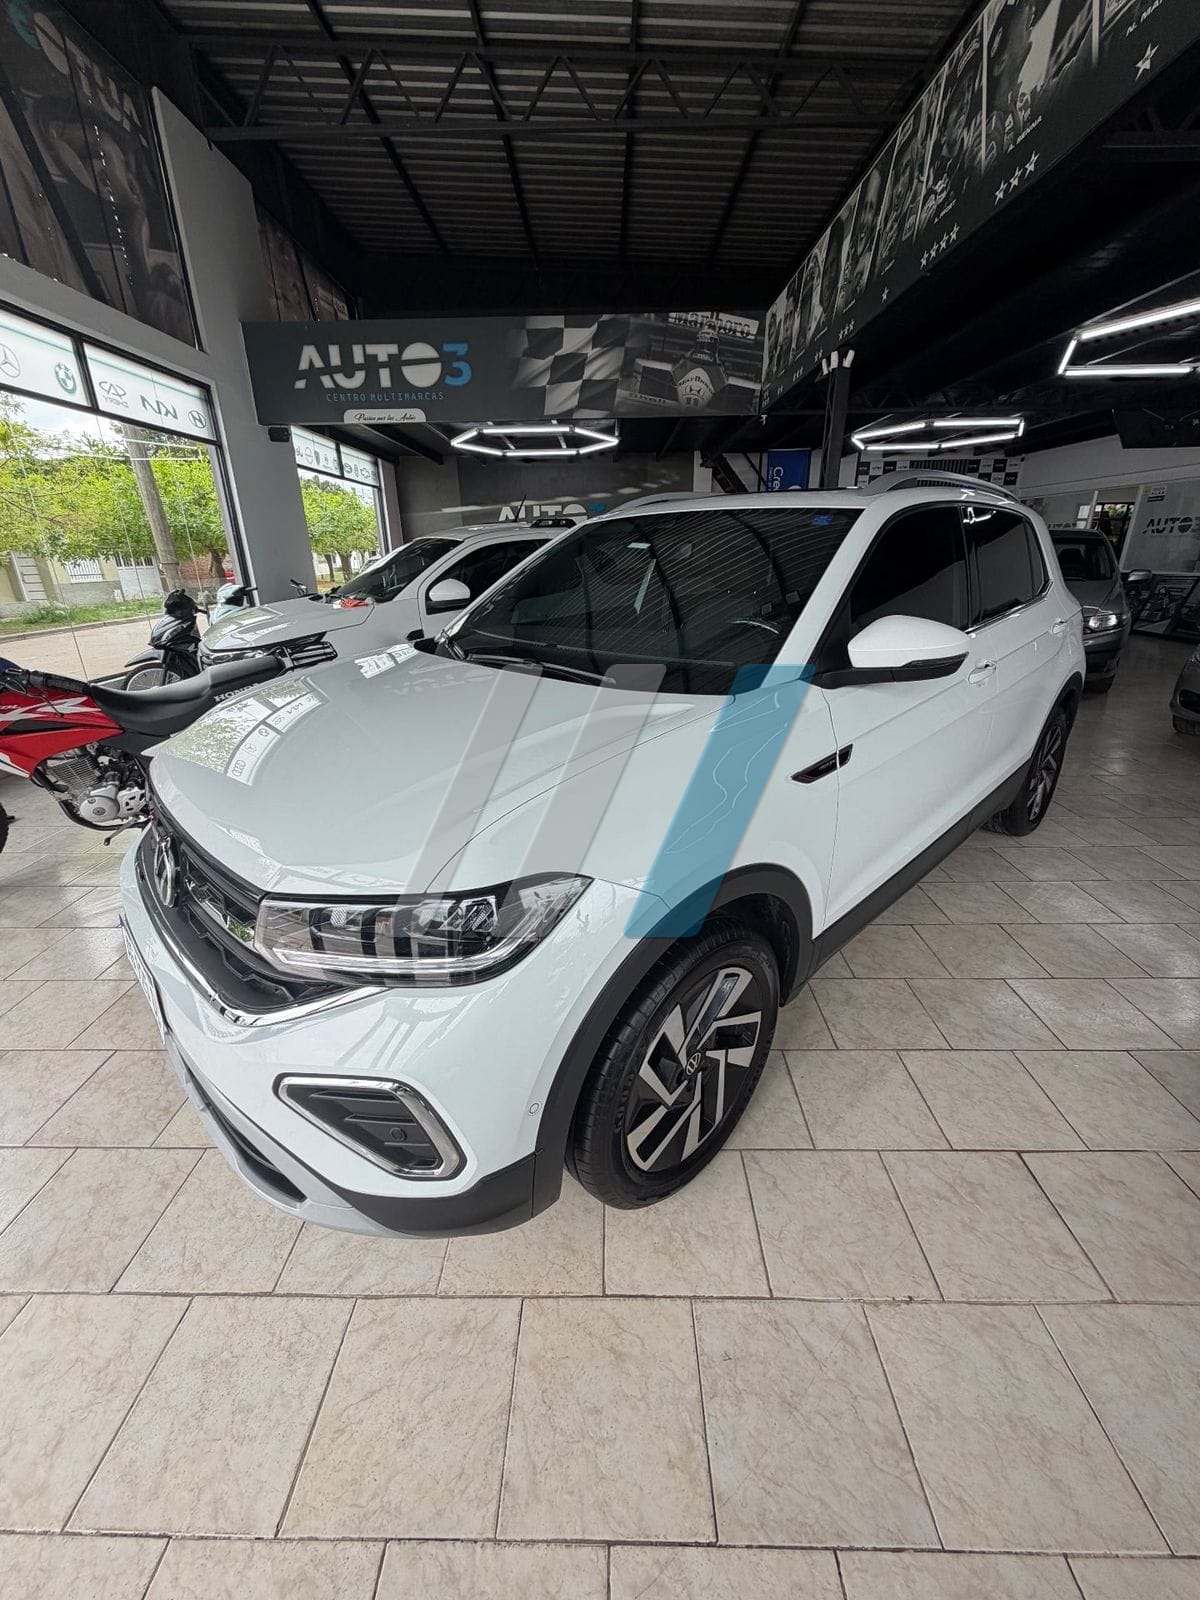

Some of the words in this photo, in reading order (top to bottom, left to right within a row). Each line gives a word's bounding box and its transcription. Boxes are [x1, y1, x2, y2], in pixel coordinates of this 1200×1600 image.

[294, 342, 472, 389] AUTO3
[326, 393, 366, 402] CENTRO
[370, 391, 444, 402] MULTIMARCAS
[773, 466, 784, 490] Cre
